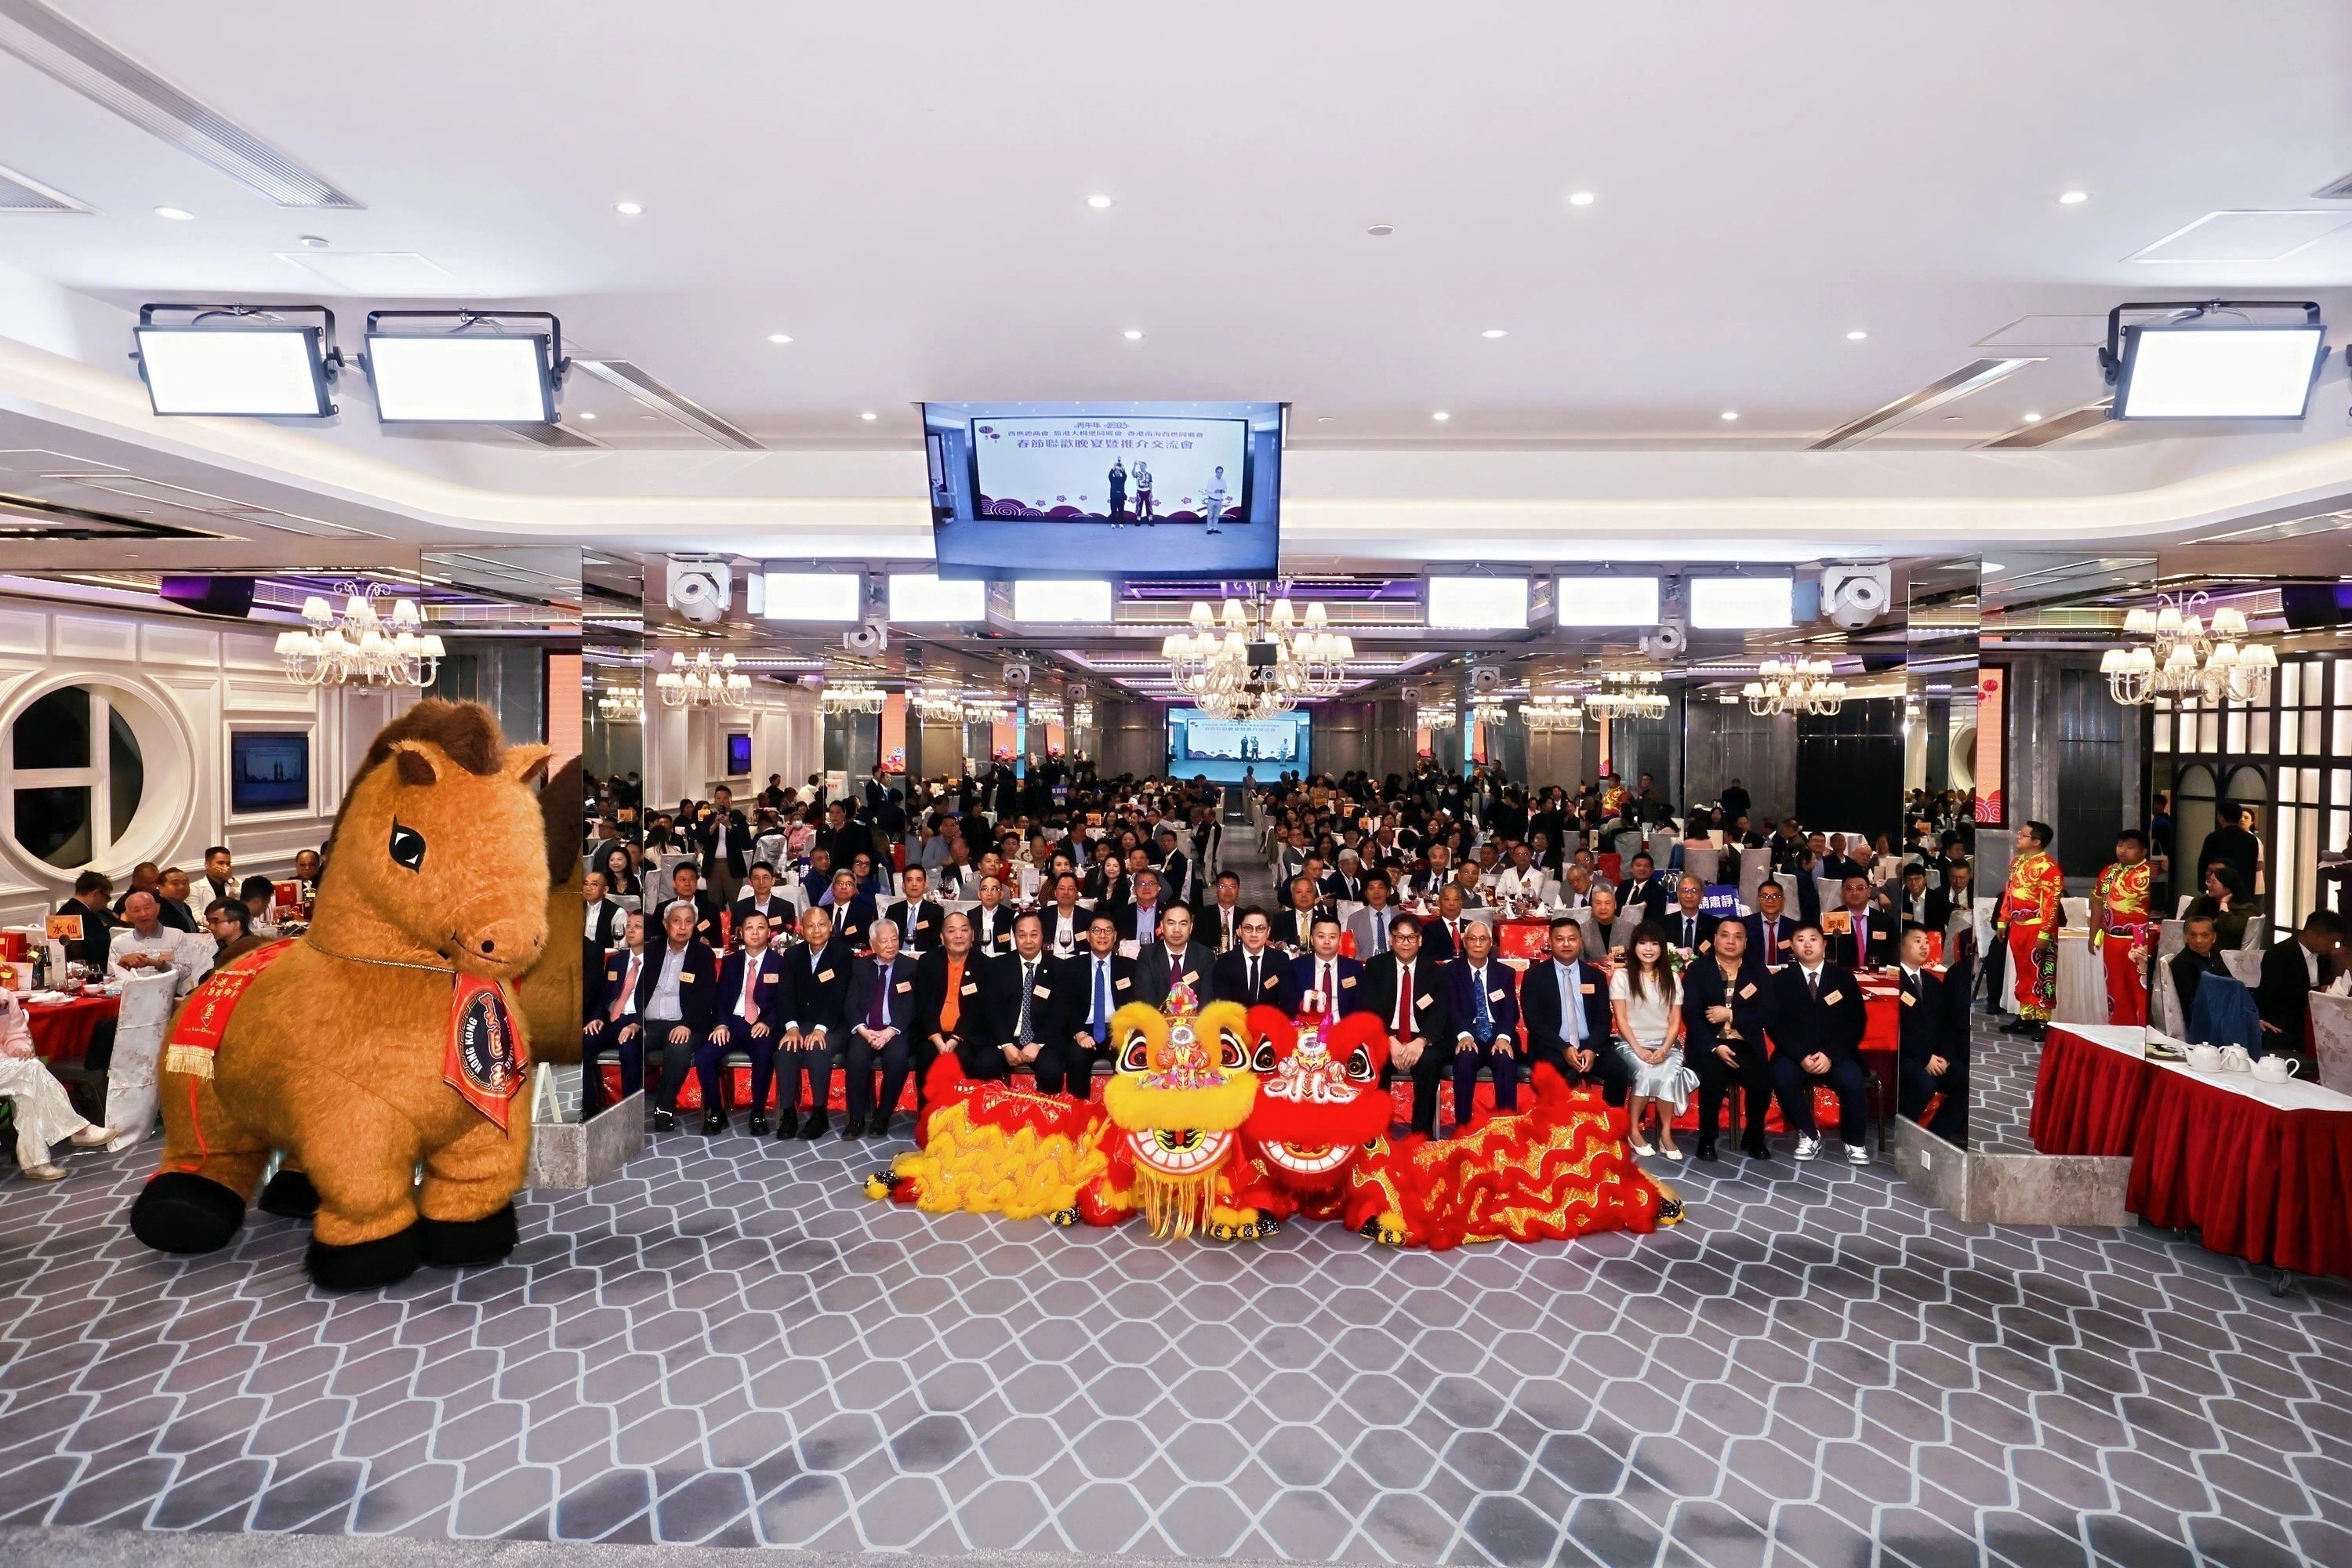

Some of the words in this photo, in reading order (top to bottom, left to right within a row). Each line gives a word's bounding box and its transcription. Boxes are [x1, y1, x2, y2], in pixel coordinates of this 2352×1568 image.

[1018, 439, 1192, 449] 春節聯歡晚宴暨推介交流會
[53, 924, 78, 934] 水仙
[465, 1017, 478, 1045] KONG
[466, 1046, 483, 1074] HONG
